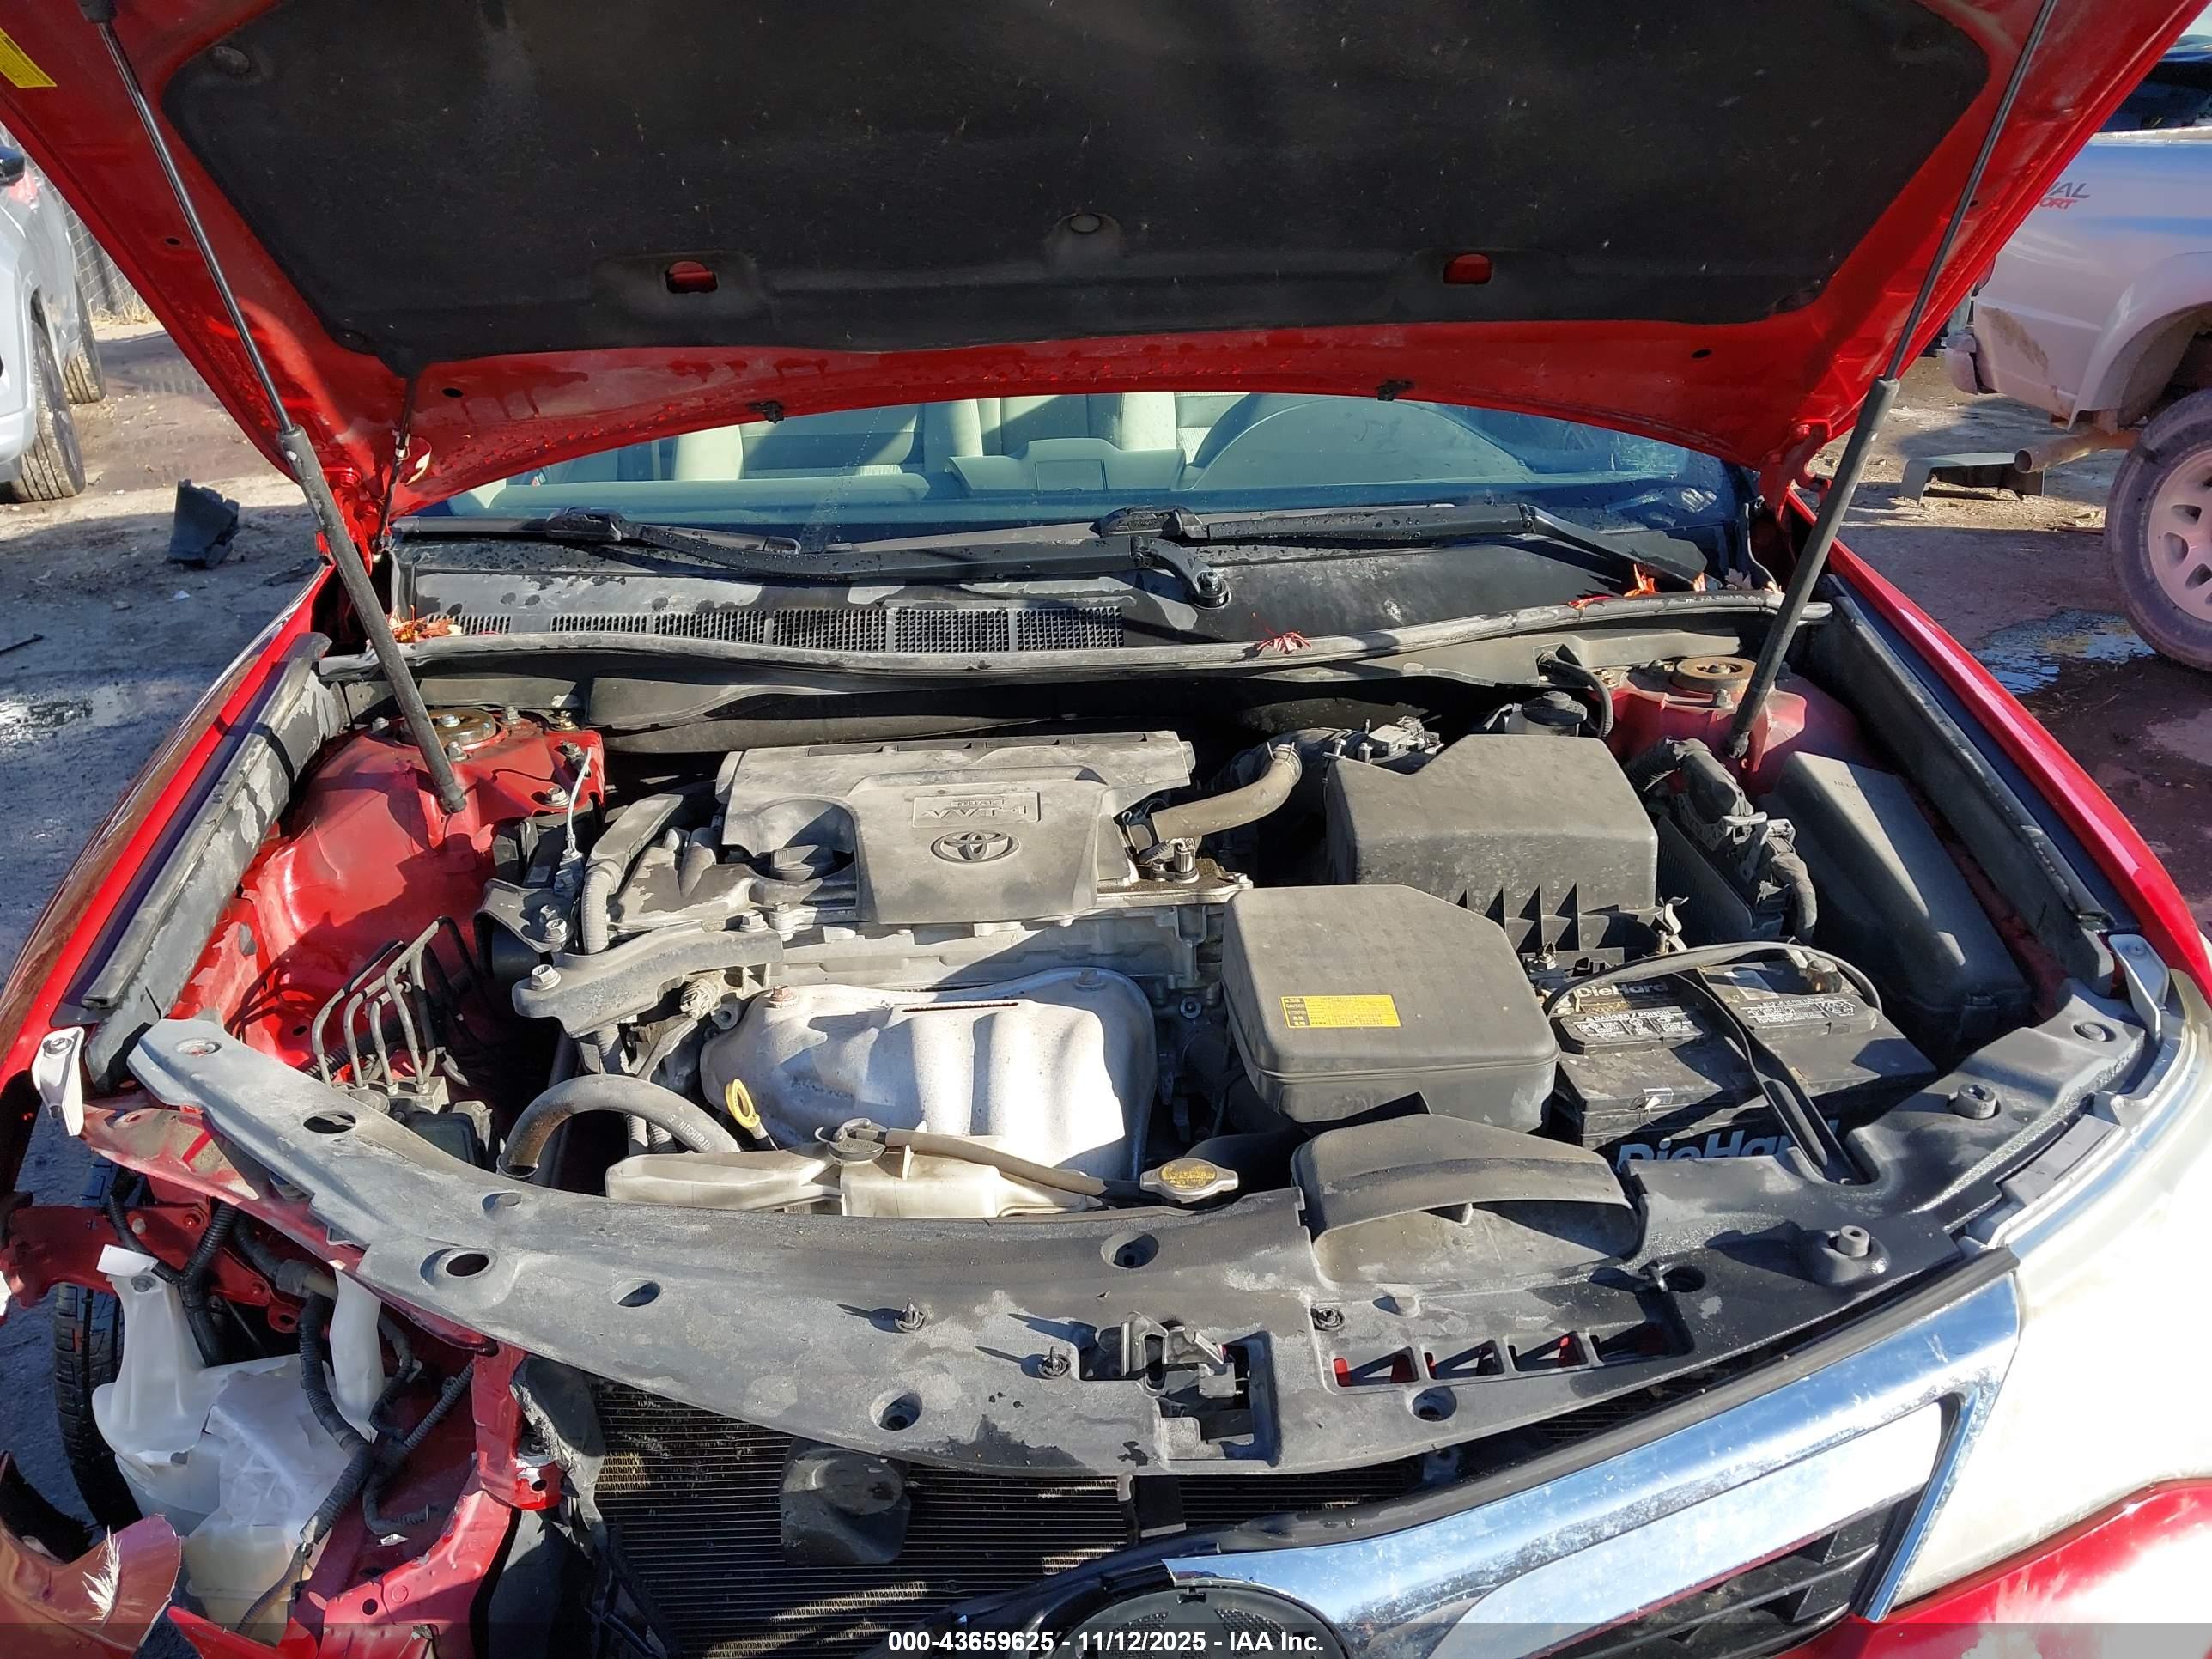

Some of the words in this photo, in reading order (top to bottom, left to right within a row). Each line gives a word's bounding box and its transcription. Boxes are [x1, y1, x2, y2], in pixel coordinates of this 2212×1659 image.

[2046, 182, 2090, 198] AL
[1577, 981, 1669, 998] DieHard
[1593, 1012, 1630, 1021] DANGER
